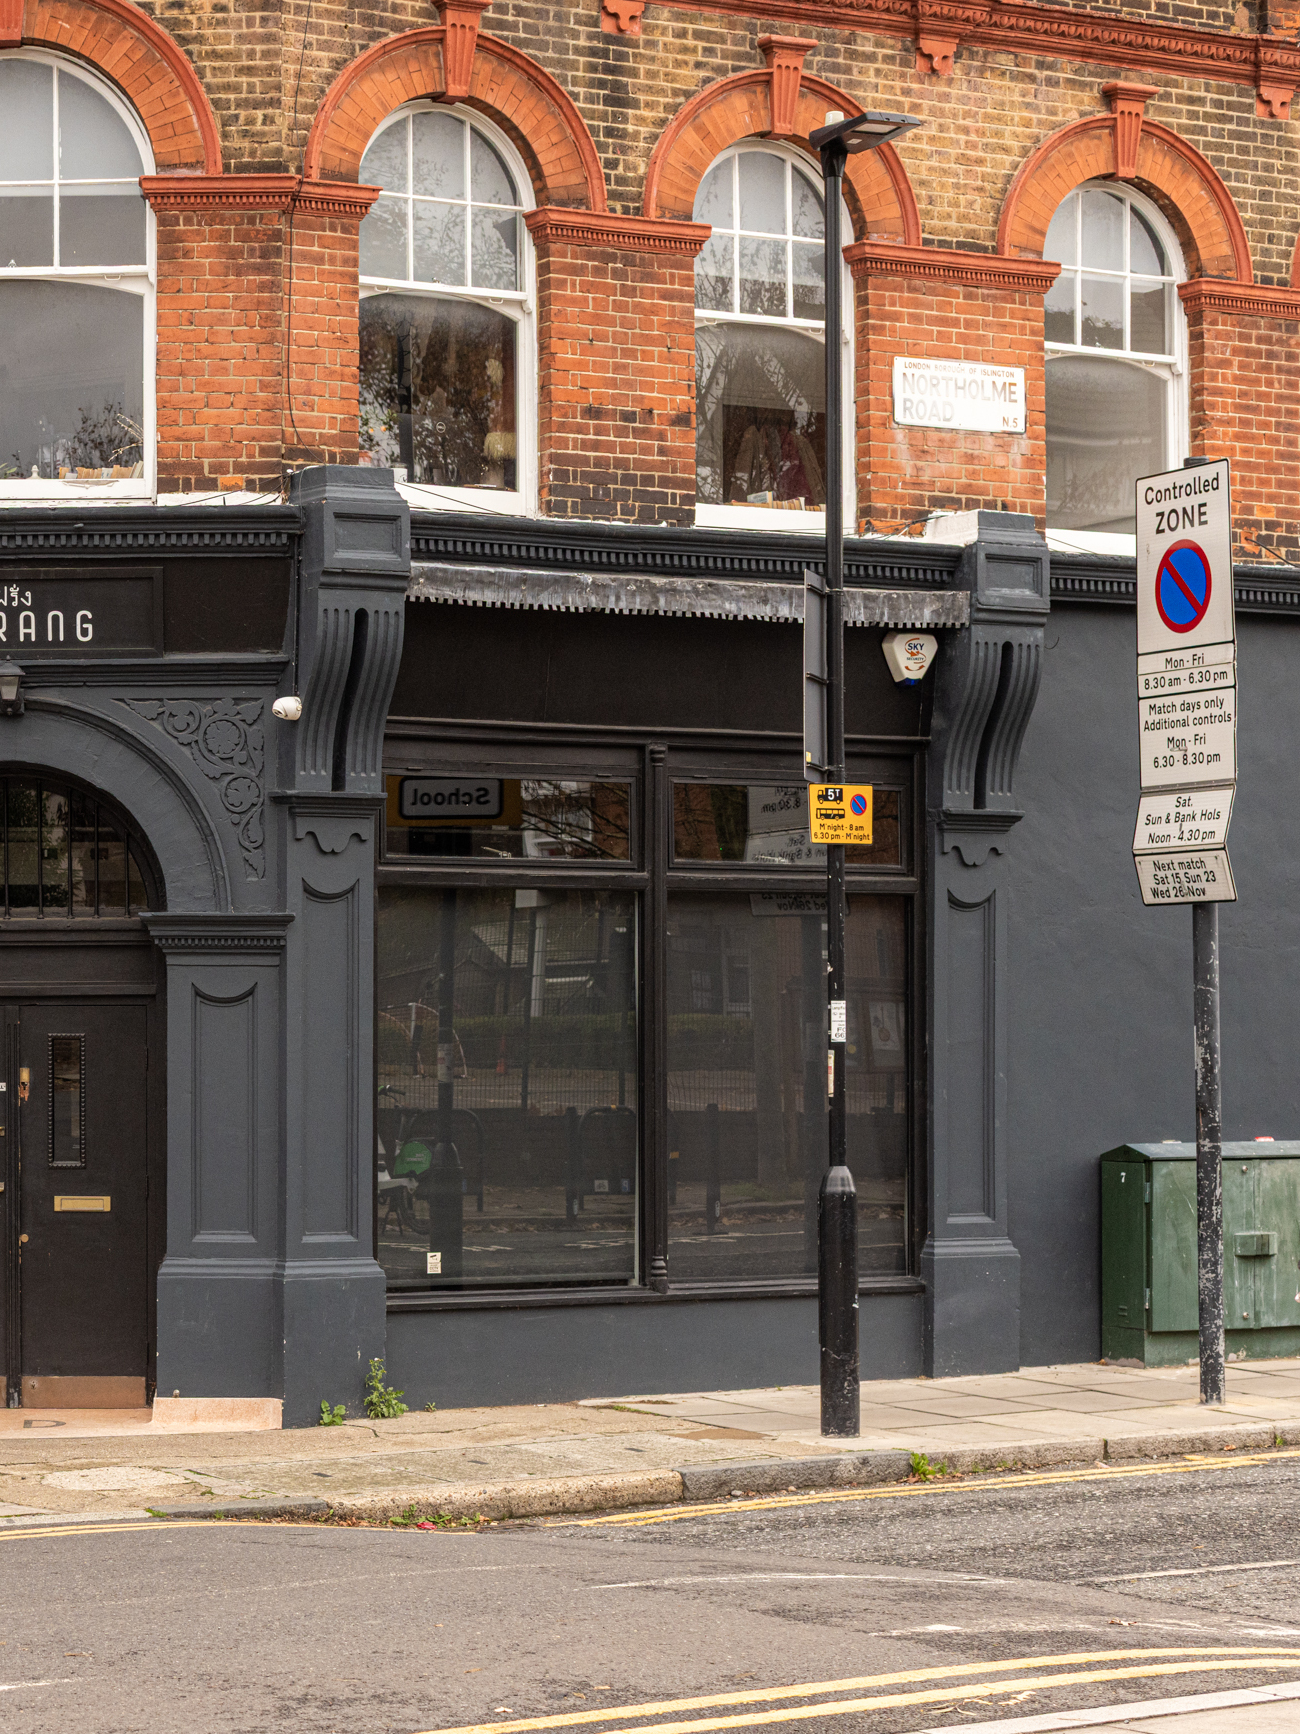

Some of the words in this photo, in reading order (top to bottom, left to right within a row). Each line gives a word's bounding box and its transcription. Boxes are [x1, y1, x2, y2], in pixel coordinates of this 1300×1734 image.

[905, 362, 930, 370] LONDON
[935, 365, 965, 374] BOROUGH
[981, 369, 1015, 378] ISLINGTON
[903, 373, 1018, 403] NORTHOLME
[903, 398, 954, 422] ROAD
[1003, 416, 1018, 428] N.5
[1145, 472, 1219, 505] Controlled
[1156, 502, 1208, 535] ZONE
[1165, 657, 1184, 669] Mon
[1192, 653, 1204, 666] Fri
[1144, 676, 1166, 690] 8.30
[1168, 677, 1181, 687] am
[1189, 670, 1210, 684] 6.30
[1213, 671, 1228, 683] pm
[1149, 701, 1177, 716] Match
[1180, 700, 1201, 713] days
[1204, 696, 1224, 709] only
[1144, 715, 1190, 731] Additional
[1193, 711, 1232, 726] controls
[1167, 737, 1186, 748] Mon
[1194, 733, 1206, 745] Fri
[1154, 755, 1175, 768] 6.30
[1183, 752, 1204, 765] 8.30
[1207, 753, 1221, 765] pm
[828, 789, 840, 800] 5T
[1175, 796, 1193, 808] Sat.
[1145, 814, 1162, 825] Sun
[1165, 812, 1171, 824] &
[1174, 811, 1197, 823] Bank
[1200, 809, 1221, 821] Hols
[820, 824, 844, 832] M'night
[846, 833, 870, 841] M'night
[1148, 833, 1171, 844] Noon
[1178, 829, 1200, 842] 4.30
[1201, 830, 1215, 842] pm
[1153, 860, 1175, 872] Next
[1178, 857, 1206, 871] match
[1153, 874, 1170, 885] Sat
[1184, 872, 1202, 884] Sun
[1204, 871, 1216, 882] 23
[1150, 887, 1171, 899] Wed
[1173, 886, 1185, 897] 26
[1187, 885, 1206, 897] Nov
[1120, 1172, 1126, 1183] 7
[23, 1420, 66, 1428] D
